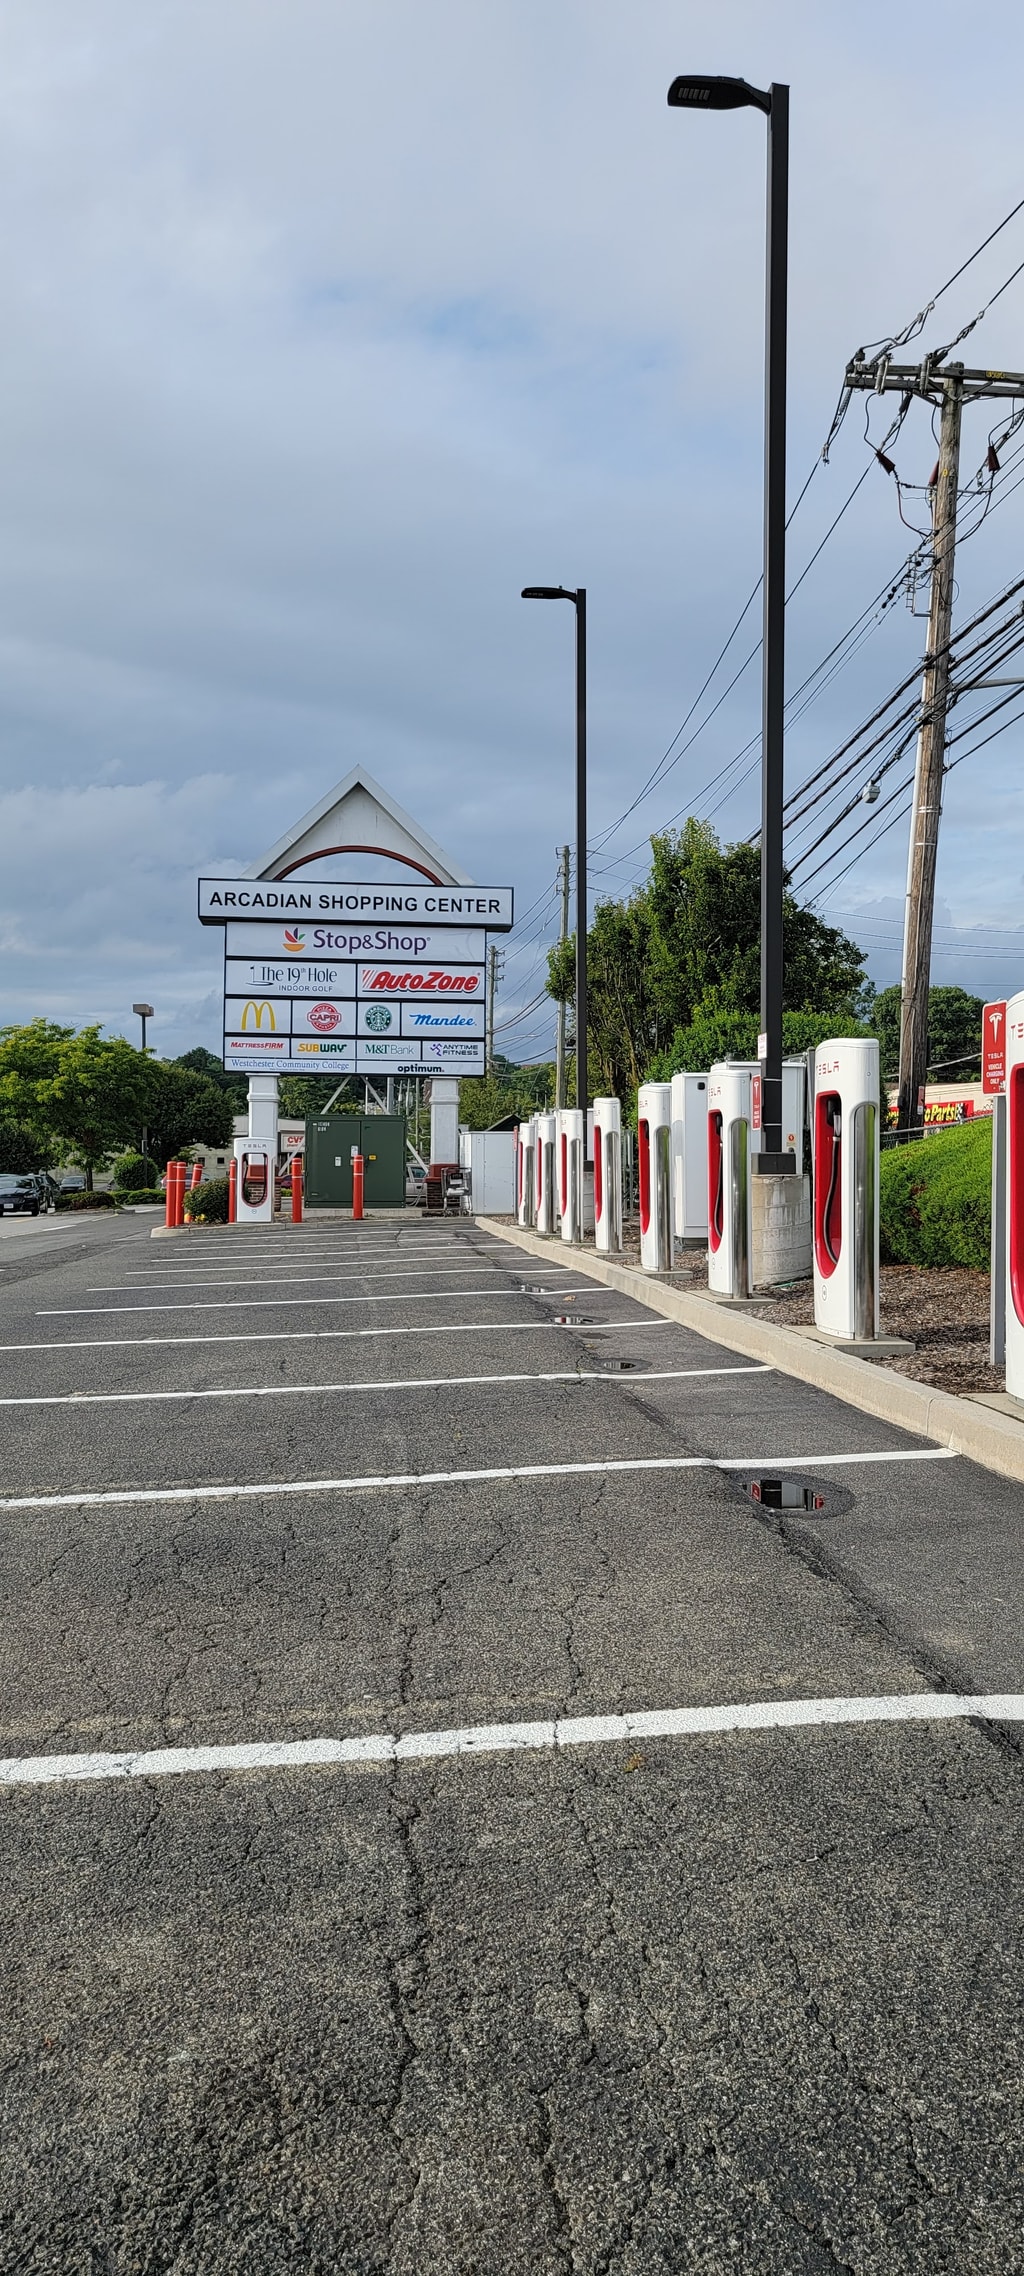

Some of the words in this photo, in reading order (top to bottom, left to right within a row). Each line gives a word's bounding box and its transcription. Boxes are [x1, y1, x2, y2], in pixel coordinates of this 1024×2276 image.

[209, 892, 311, 908] ARCADIAN
[318, 894, 417, 911] SHOPPING
[424, 897, 500, 913] CENTER
[313, 929, 427, 955] Stop&Shop
[261, 966, 284, 981] The
[287, 967, 307, 985] 19th
[308, 967, 337, 983] Hole
[370, 971, 479, 991] AutoZone
[309, 1014, 340, 1022] CAPRI
[409, 1014, 475, 1026] Mandee
[297, 1043, 348, 1053] SUBWAY
[365, 1044, 390, 1054] M&T
[391, 1045, 414, 1055] Bank
[987, 1052, 1004, 1060] TESLA
[231, 1058, 275, 1067] Westchester
[276, 1060, 319, 1070] Community
[321, 1061, 350, 1070] College
